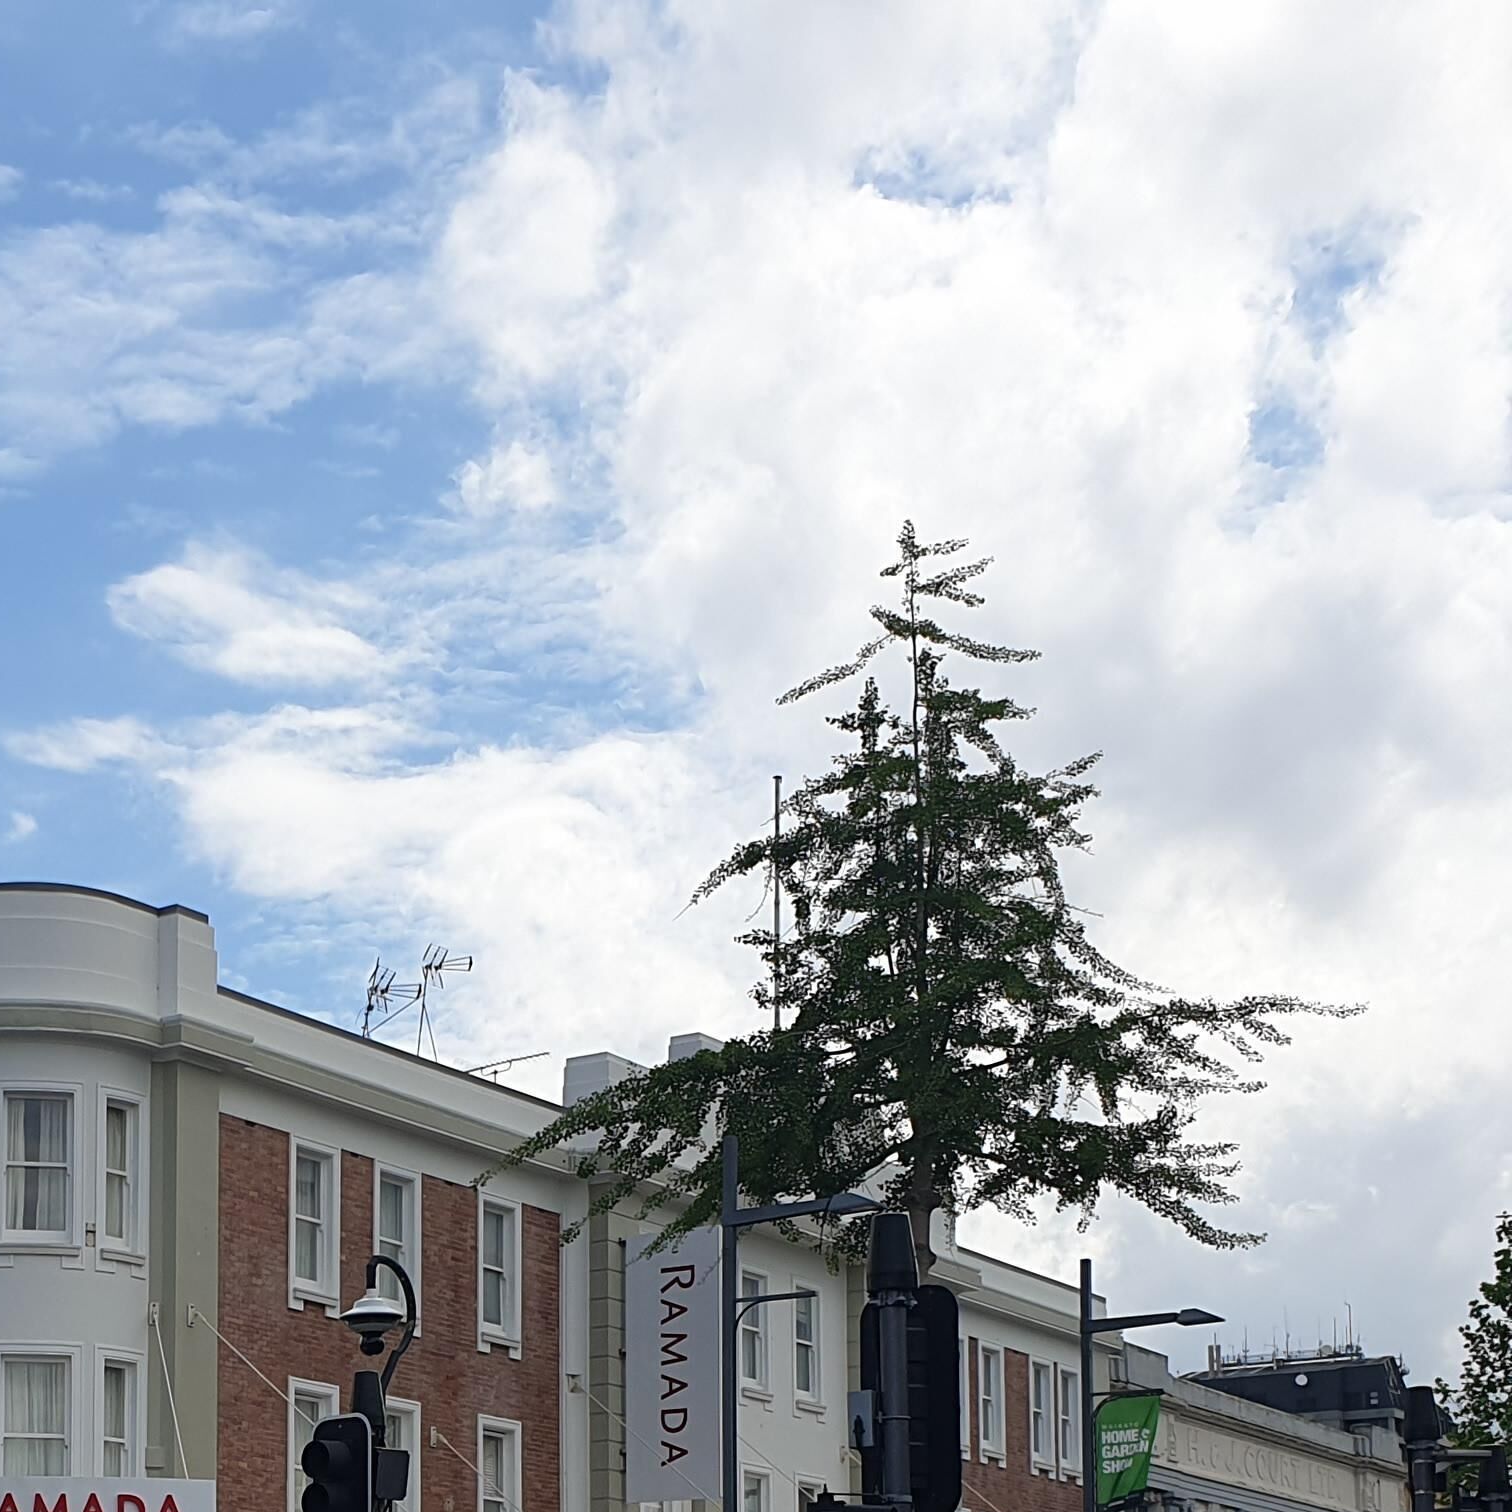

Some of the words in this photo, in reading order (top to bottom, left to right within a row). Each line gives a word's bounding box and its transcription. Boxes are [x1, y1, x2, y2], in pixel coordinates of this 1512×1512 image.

[660, 1264, 695, 1467] RAMADA
[1101, 1428, 1139, 1445] HOME
[1244, 1445, 1302, 1490] COURT
